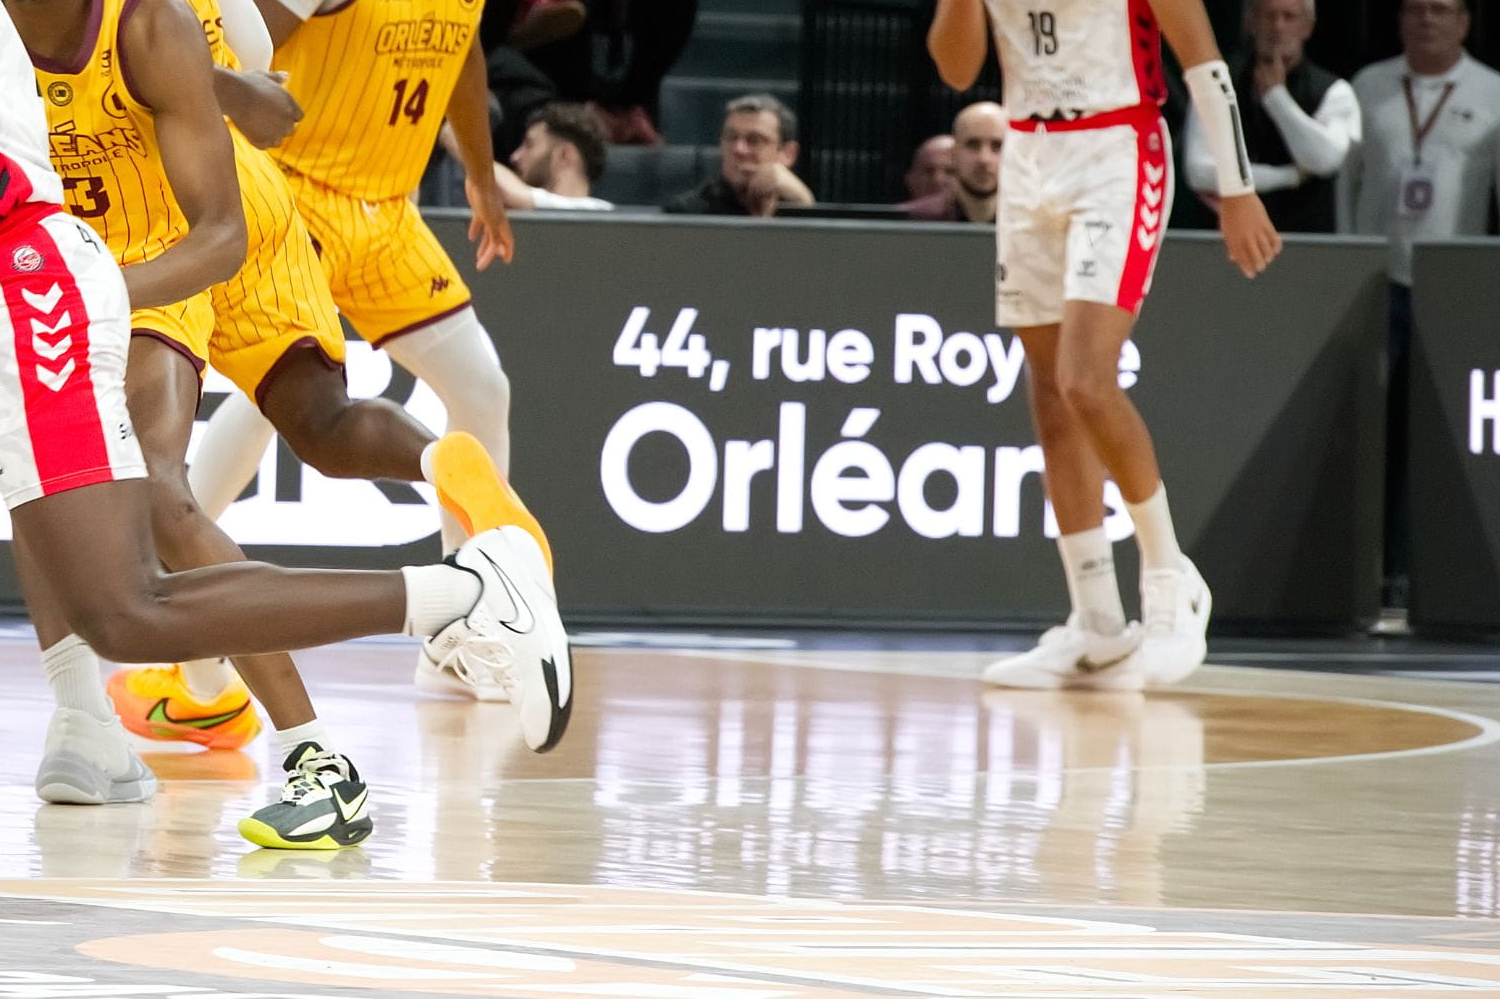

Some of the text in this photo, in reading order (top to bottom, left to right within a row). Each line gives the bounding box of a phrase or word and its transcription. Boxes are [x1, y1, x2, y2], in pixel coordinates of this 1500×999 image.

[375, 11, 470, 54] ORLÉANS
[1028, 11, 1058, 56] 19
[388, 78, 429, 127] 14
[63, 177, 111, 218] 3
[612, 306, 729, 393] 44,
[751, 326, 875, 384] rue
[1469, 367, 1500, 455] H
